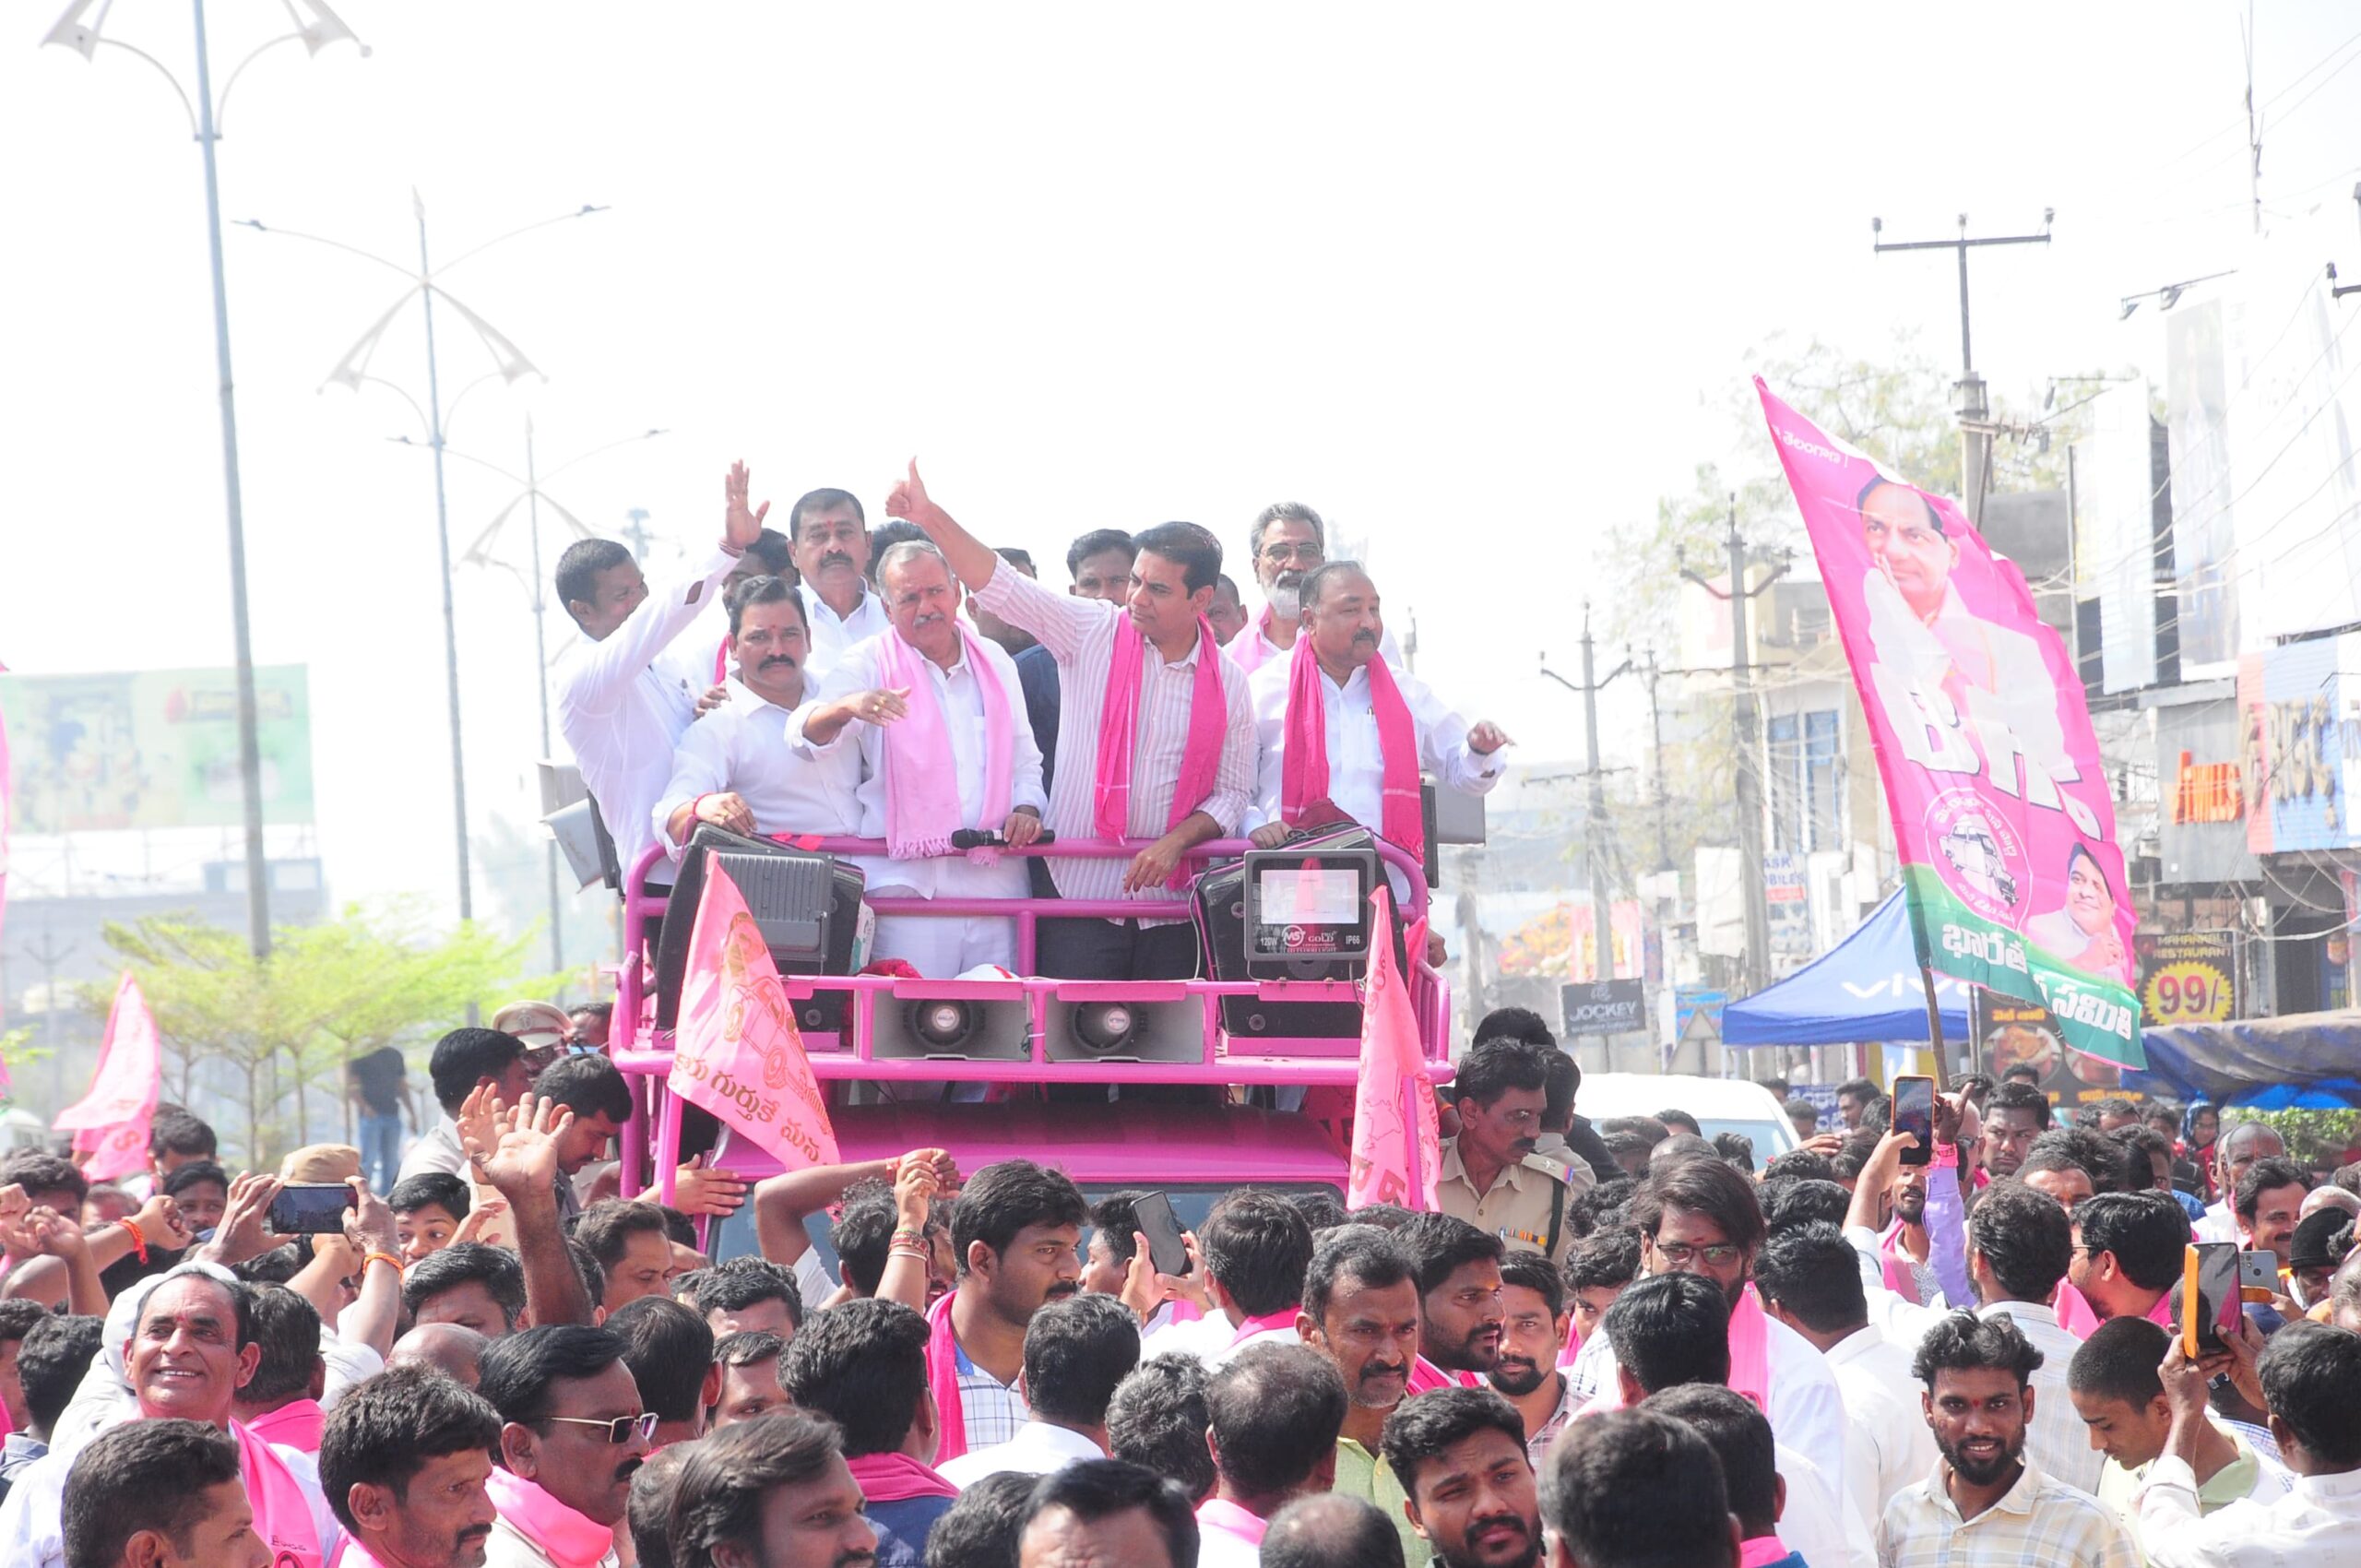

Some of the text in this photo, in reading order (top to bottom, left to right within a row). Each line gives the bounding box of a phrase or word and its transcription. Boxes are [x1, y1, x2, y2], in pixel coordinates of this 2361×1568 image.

[1762, 872, 1805, 885] BILES
[1345, 934, 1360, 945] IP66
[1942, 924, 2028, 975] భారత
[2052, 982, 2131, 1040] సమితి
[2157, 975, 2225, 1015] 99/-
[1569, 1000, 1637, 1022] JOCKEY
